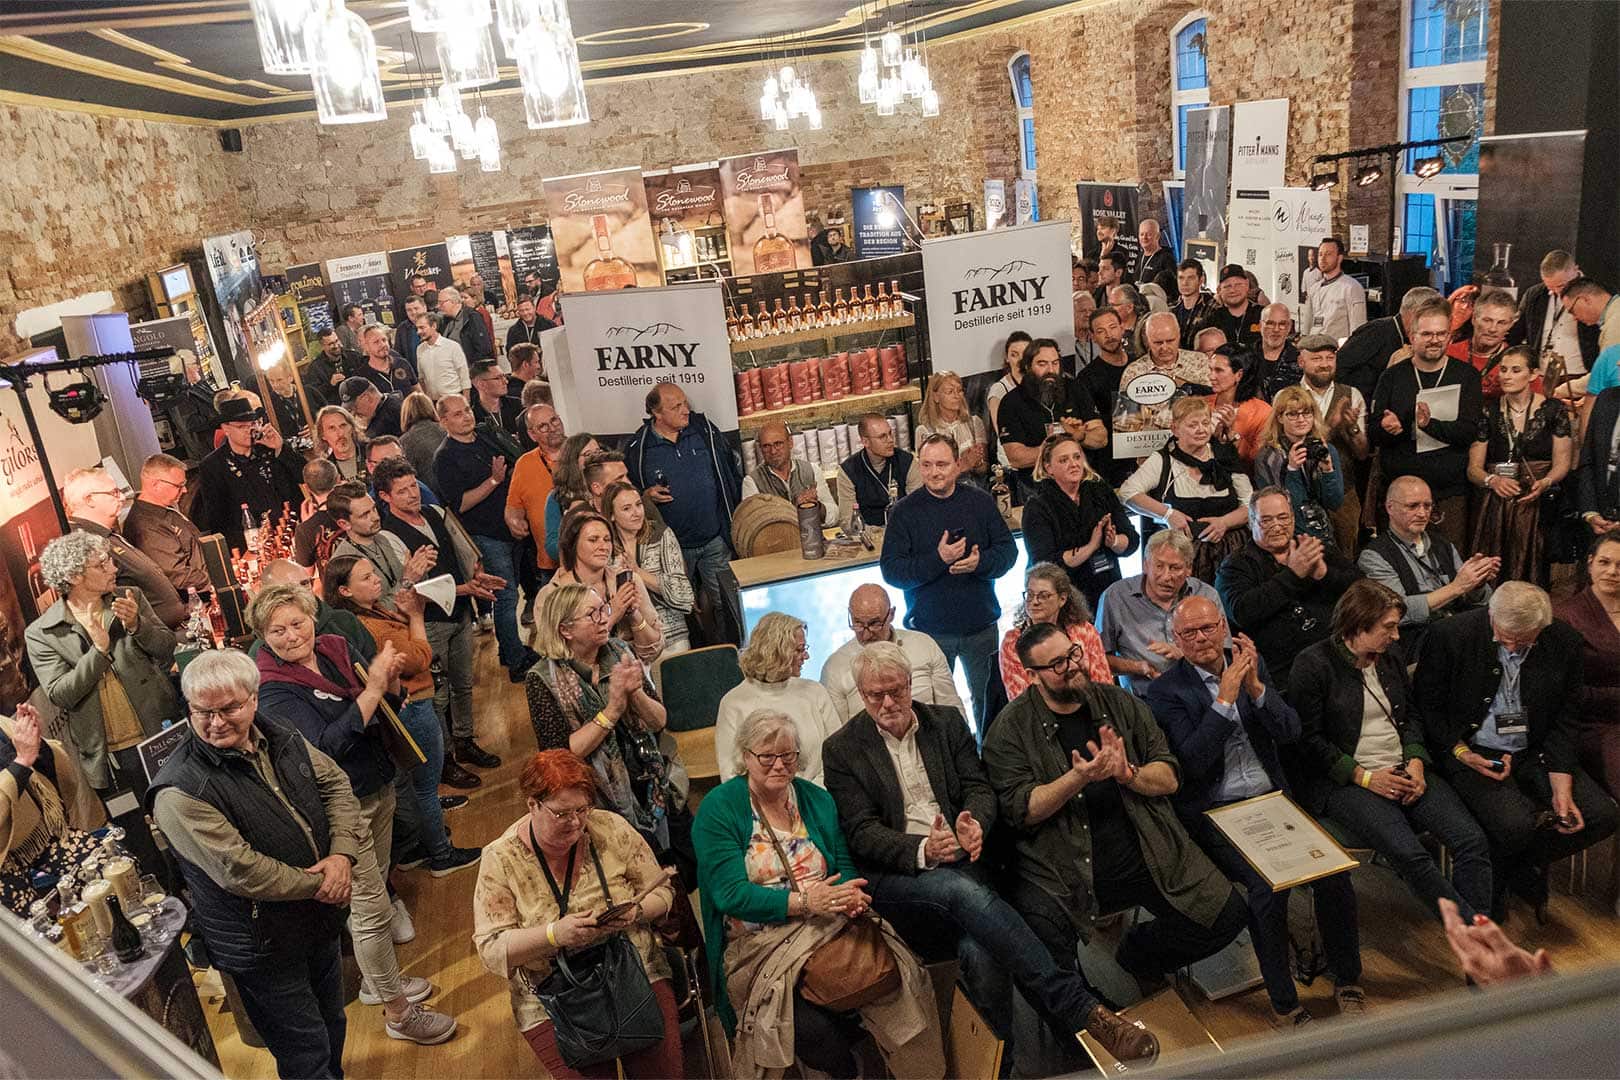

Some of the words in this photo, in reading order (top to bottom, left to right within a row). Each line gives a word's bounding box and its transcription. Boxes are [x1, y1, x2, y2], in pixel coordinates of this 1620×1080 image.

[736, 168, 790, 190] Stonewood
[563, 188, 631, 211] Stonewood
[655, 189, 717, 211] Stonewood
[952, 275, 1050, 315] FARNY
[954, 312, 1004, 331] Destillerie
[1006, 308, 1025, 321] seit
[1027, 303, 1052, 317] 1919
[594, 343, 701, 372] FARNY
[598, 374, 653, 387] Destillerie
[655, 373, 678, 385] seit
[679, 372, 705, 384] 1919
[1135, 384, 1168, 394] FARNY
